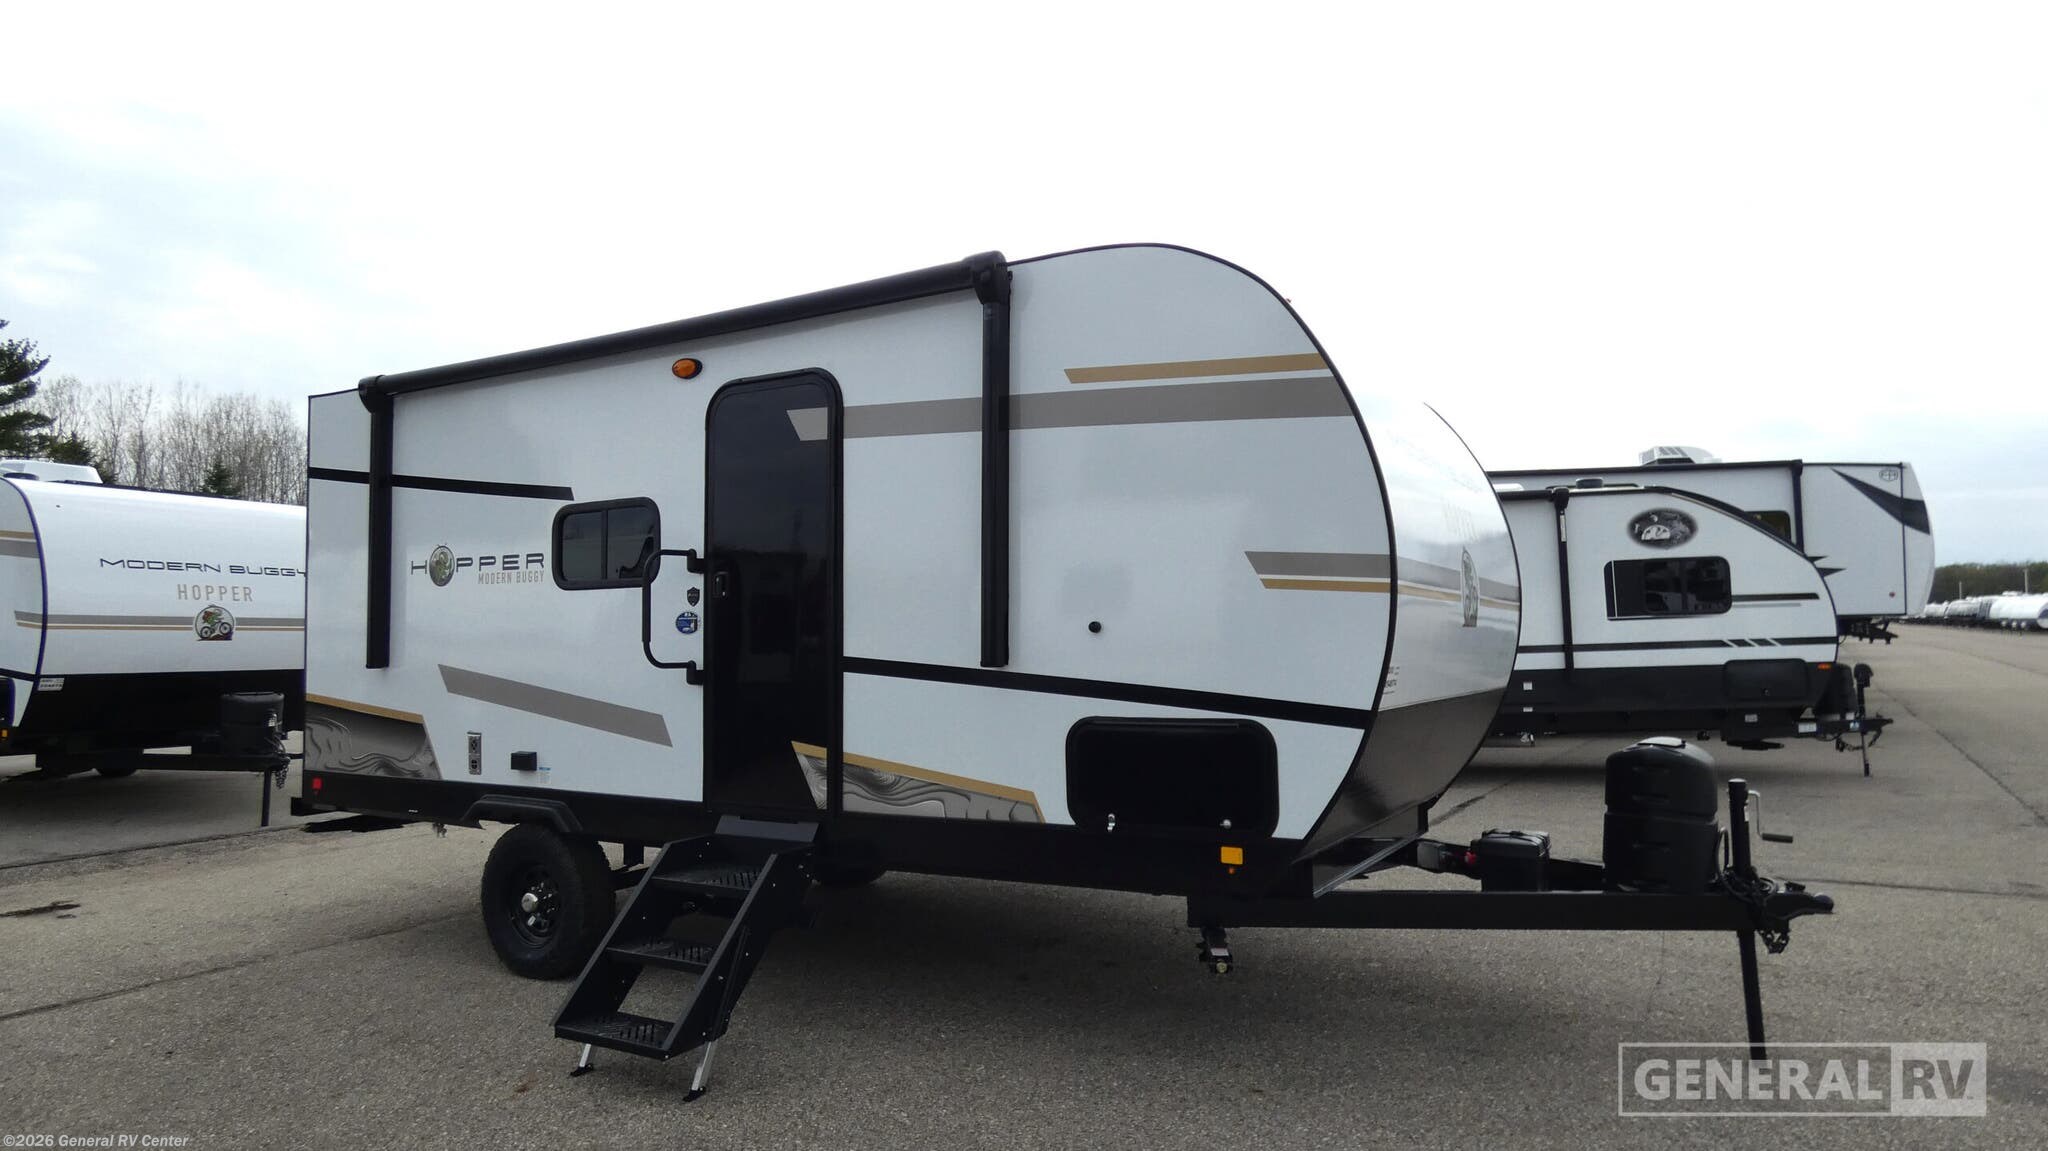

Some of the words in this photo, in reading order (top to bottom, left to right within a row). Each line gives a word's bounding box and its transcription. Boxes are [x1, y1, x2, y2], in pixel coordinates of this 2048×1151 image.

[100, 558, 221, 573] MODERN
[411, 546, 545, 587] HOPPER
[478, 572, 512, 585] MODERN
[516, 570, 545, 583] BUGGY
[177, 583, 253, 602] HOPPER
